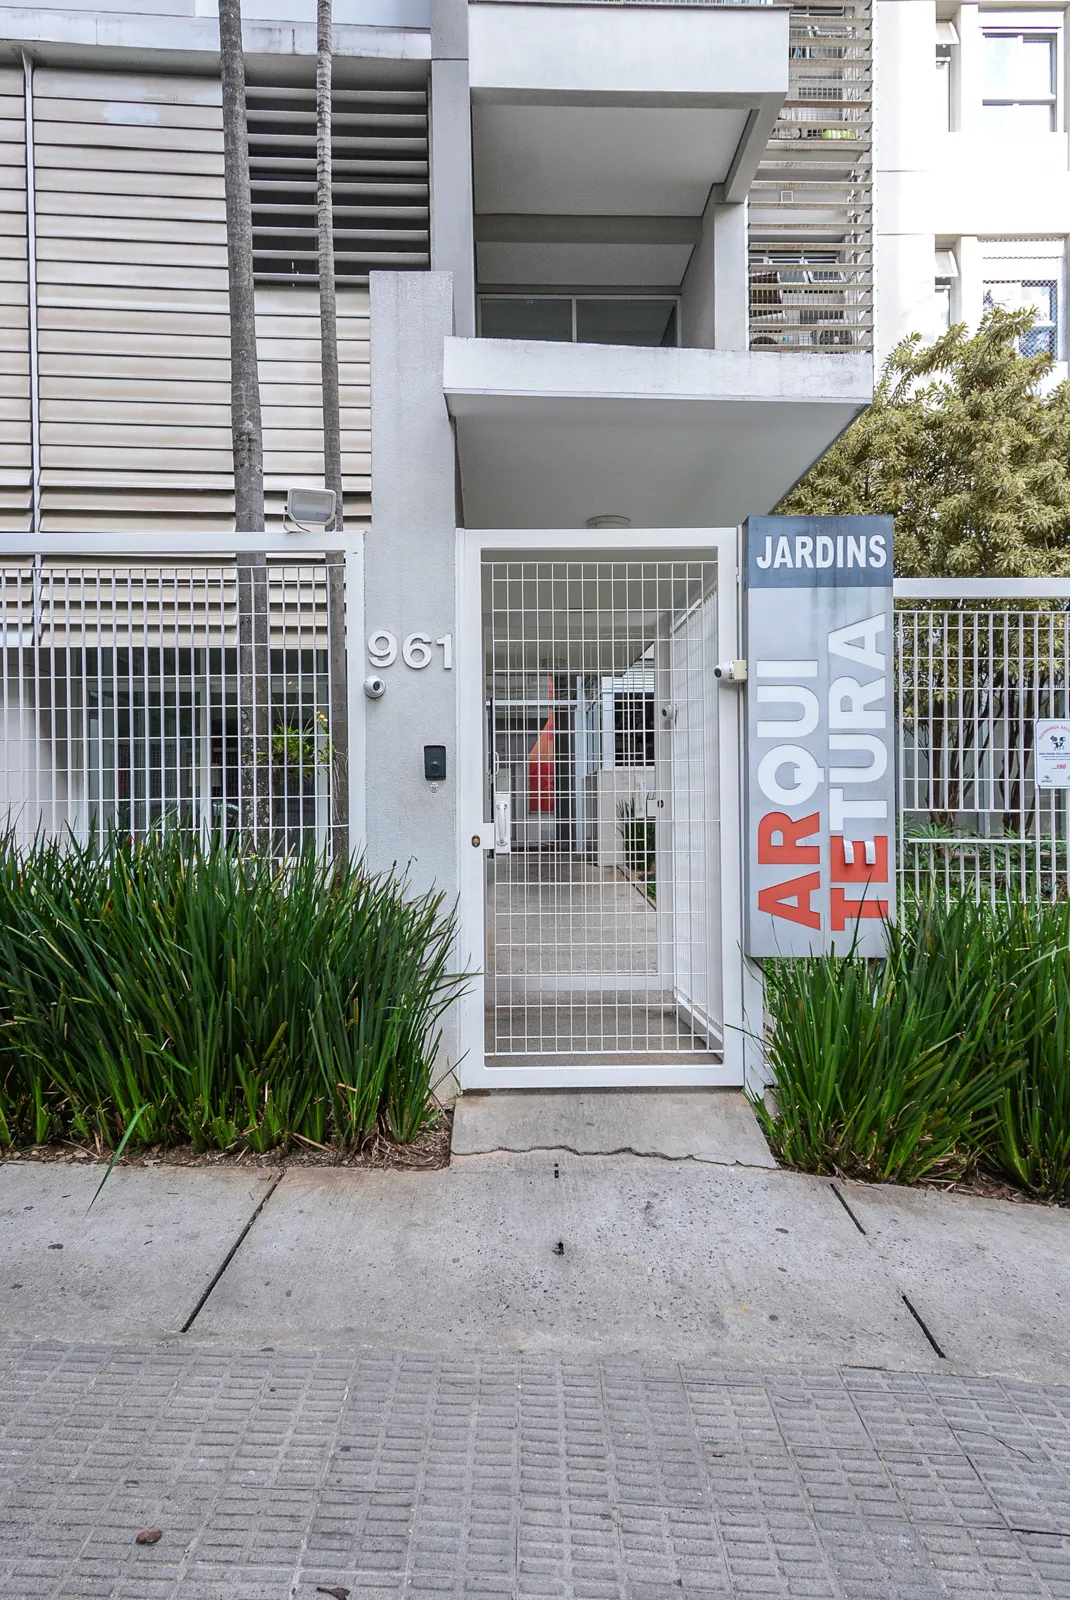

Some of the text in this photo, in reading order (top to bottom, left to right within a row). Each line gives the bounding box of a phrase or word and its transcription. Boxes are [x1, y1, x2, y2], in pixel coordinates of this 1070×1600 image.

[756, 534, 887, 569] JARDINS
[368, 630, 452, 669] 961
[757, 660, 825, 931] ARQUI
[828, 612, 888, 931] TETURA
